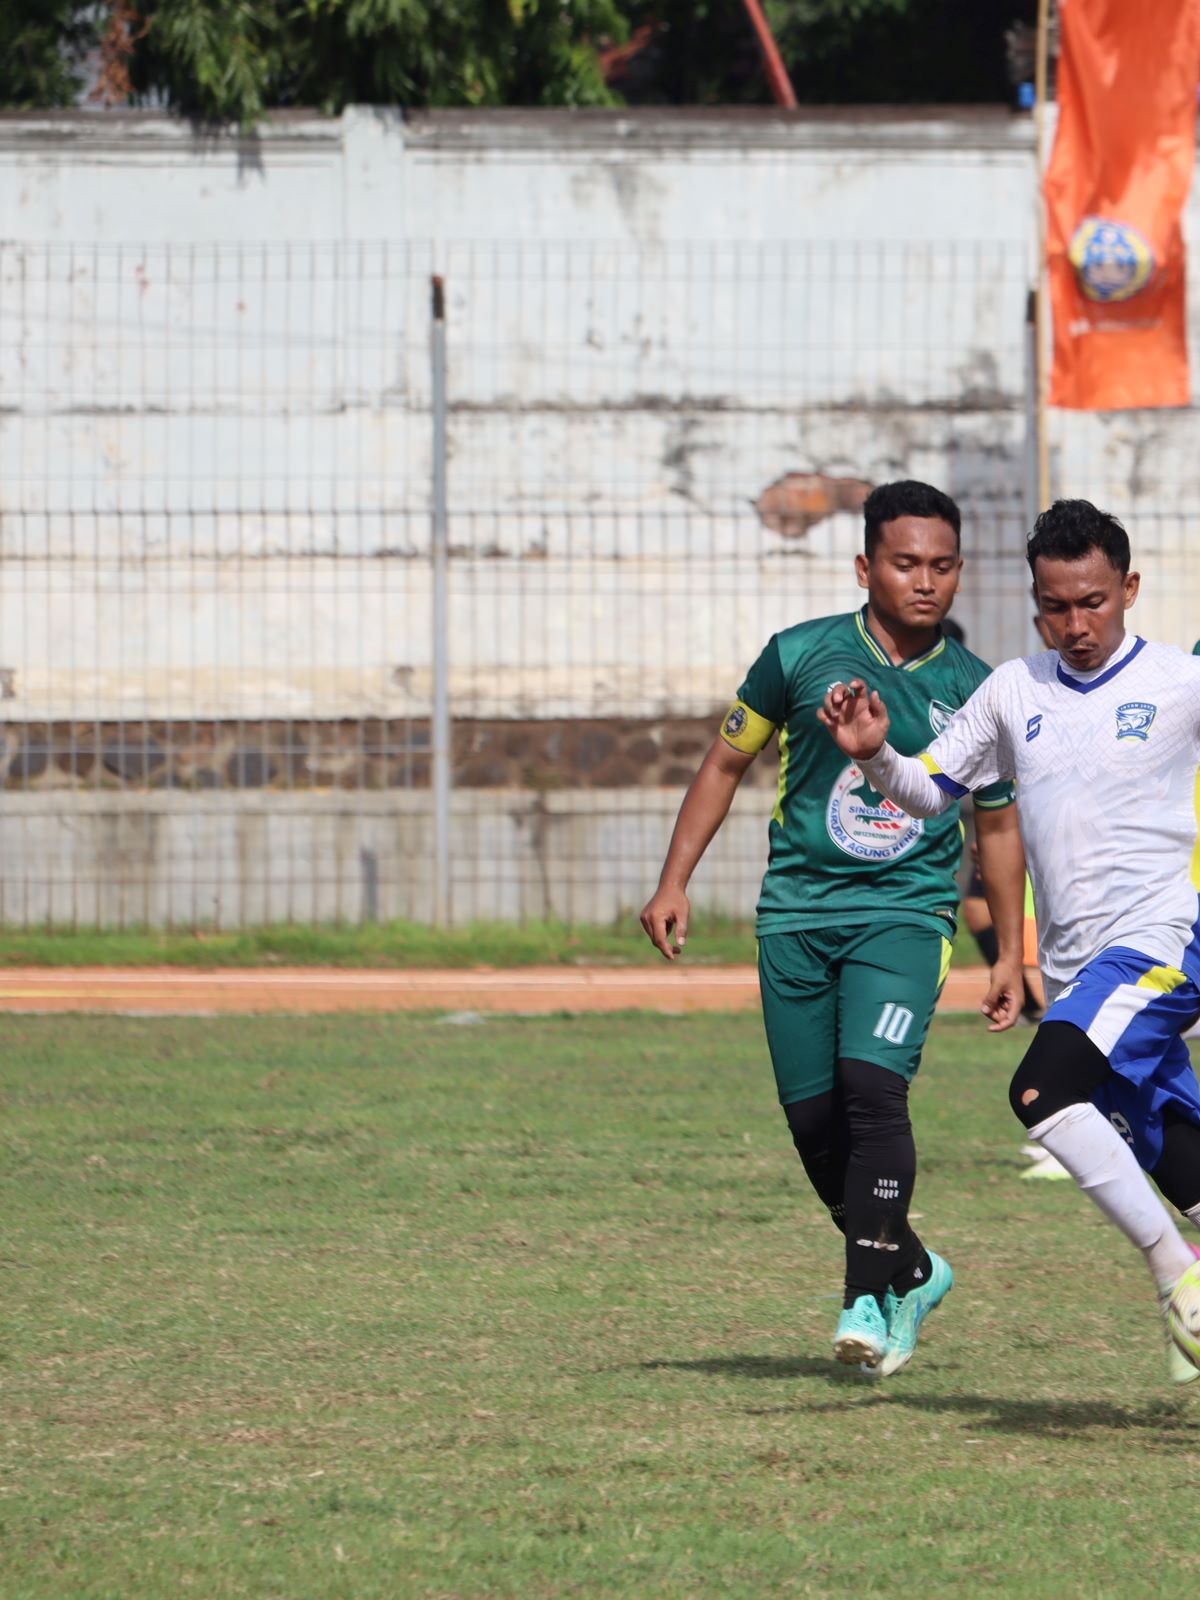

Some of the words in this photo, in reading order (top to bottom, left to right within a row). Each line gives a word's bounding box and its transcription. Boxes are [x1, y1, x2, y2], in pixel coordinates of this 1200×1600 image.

[830, 799, 848, 843] GARUDA
[847, 842, 891, 858] AGUNG
[872, 1002, 915, 1045] 10
